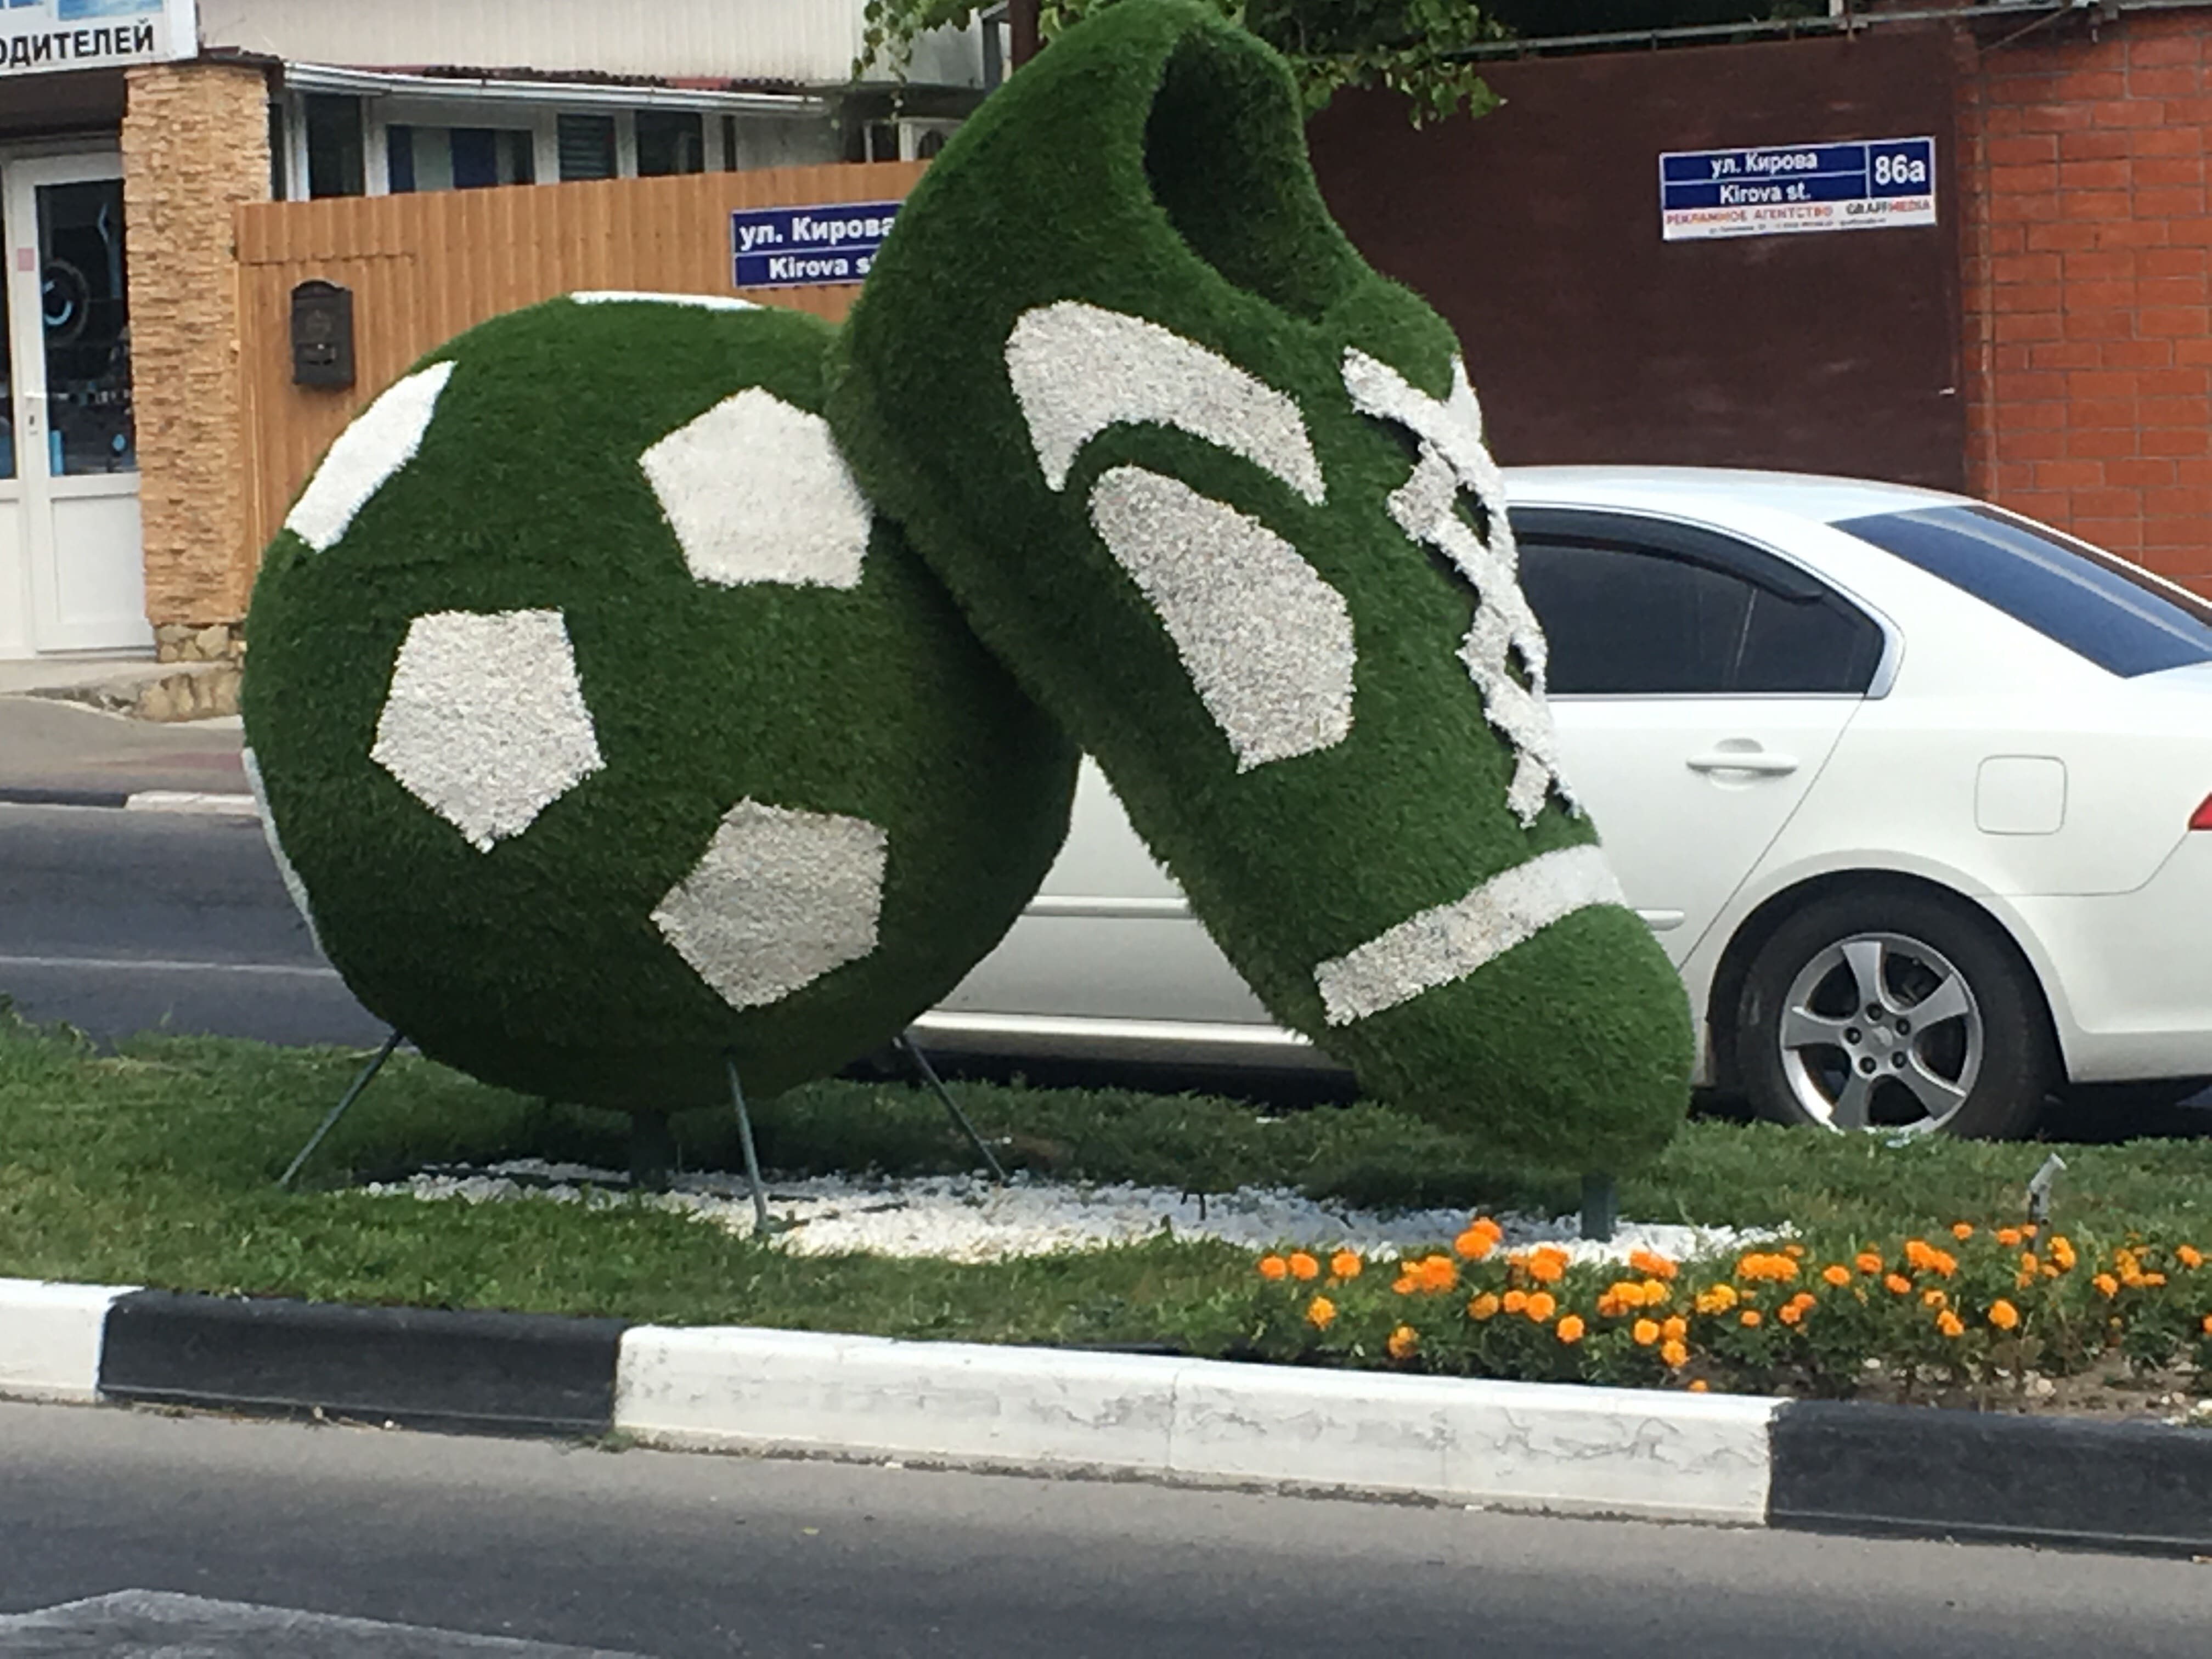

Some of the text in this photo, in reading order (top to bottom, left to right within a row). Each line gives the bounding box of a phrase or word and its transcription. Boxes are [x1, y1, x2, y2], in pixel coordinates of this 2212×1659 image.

[1711, 152, 1818, 179] ул. Кирова
[1720, 182, 1811, 205] Kirova st.
[739, 217, 895, 251] ул. Кирова
[769, 252, 878, 280] Kirova s
